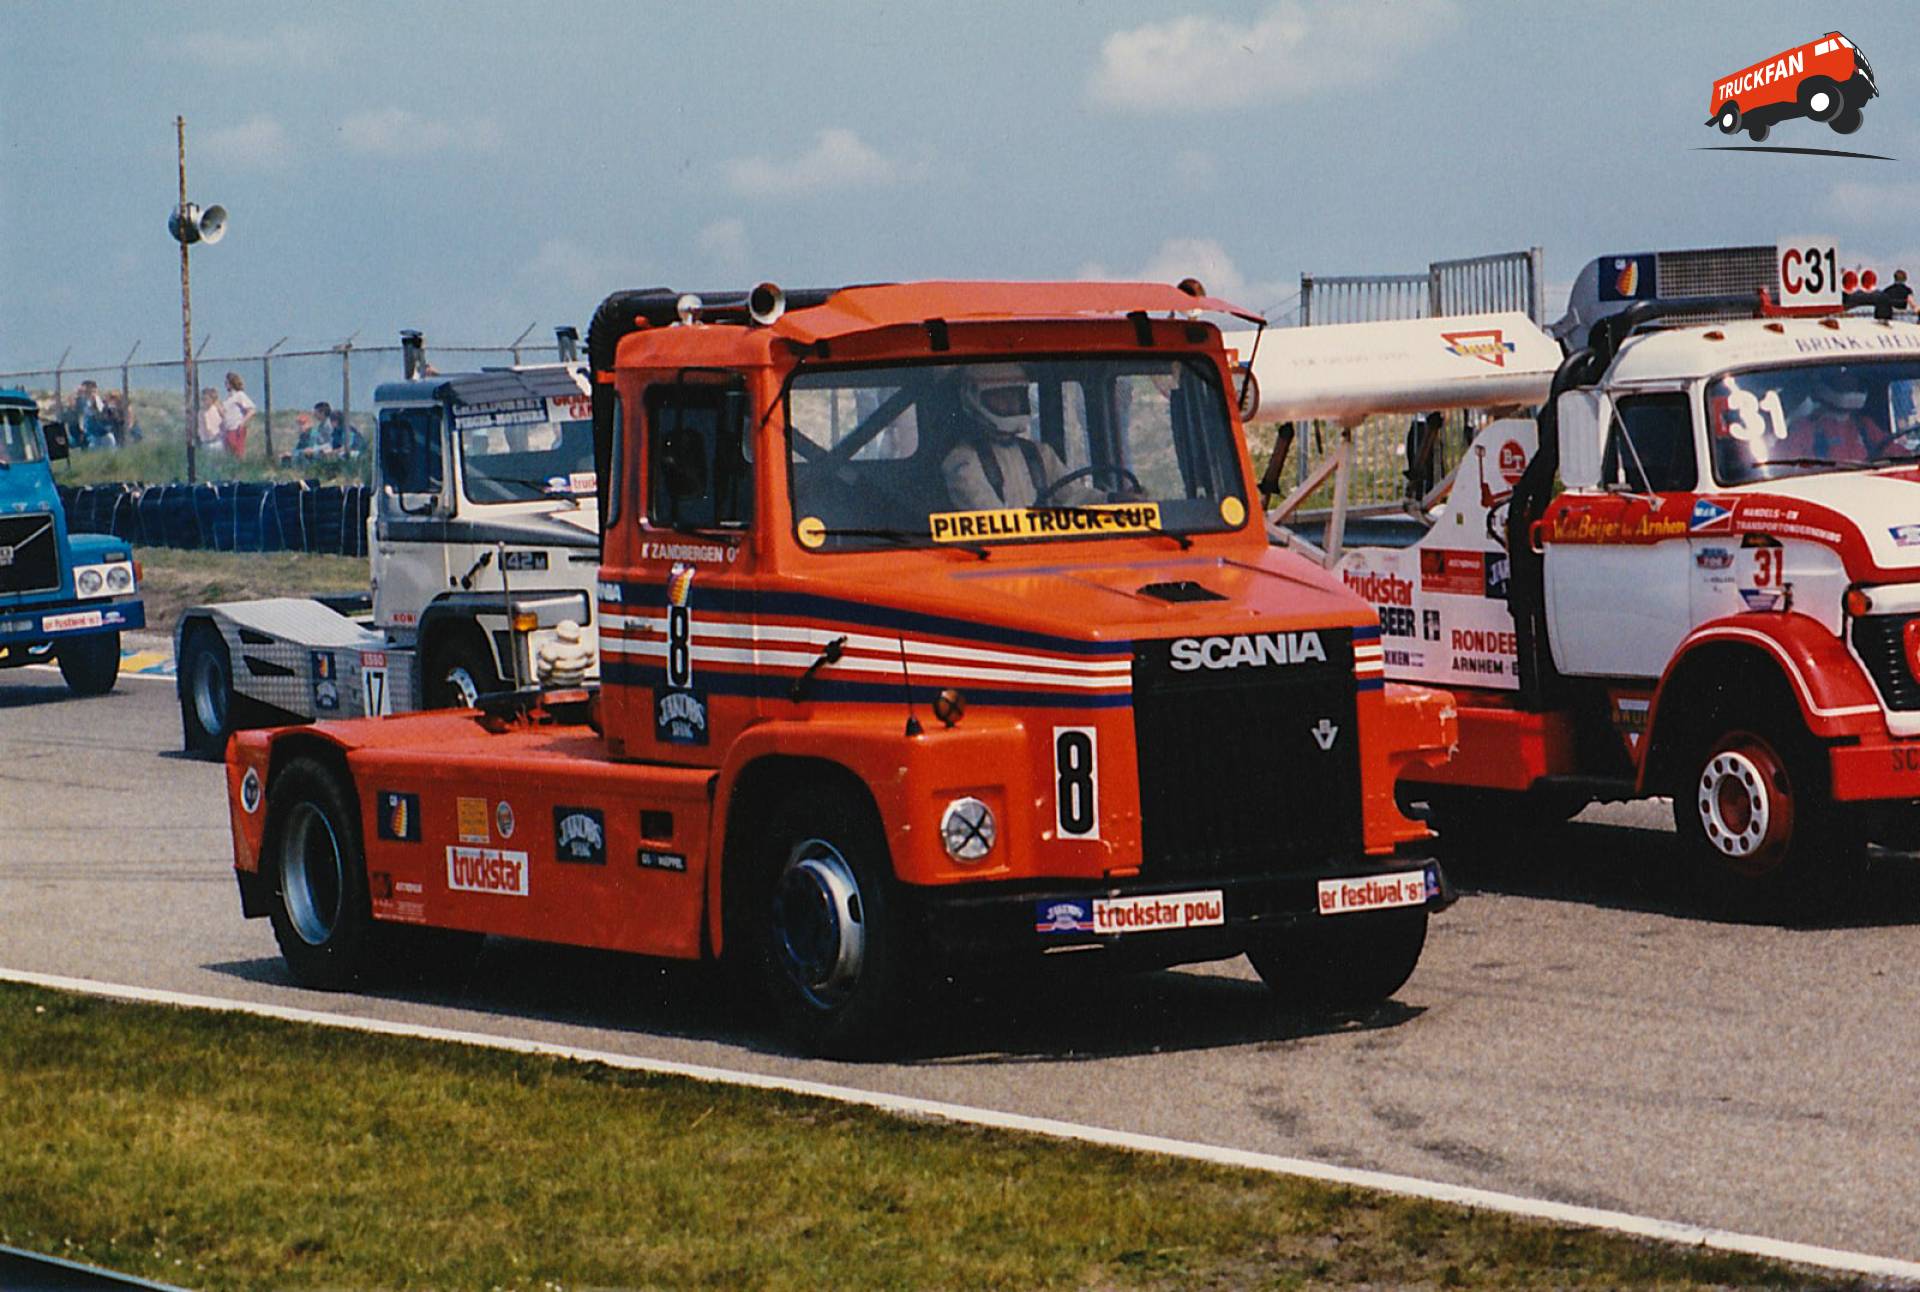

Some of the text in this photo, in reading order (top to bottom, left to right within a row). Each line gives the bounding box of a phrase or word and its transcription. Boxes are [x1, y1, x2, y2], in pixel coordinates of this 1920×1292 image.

[1782, 247, 1836, 295] C31
[933, 506, 1157, 538] PIRELLI TRUCK-CUP
[652, 543, 723, 562] ZANDBERGEN
[1753, 549, 1783, 587] 31
[671, 606, 689, 686] 8
[1169, 631, 1328, 672] SCANIA
[1452, 657, 1504, 674] ARNHEM
[366, 671, 384, 717] 17
[1057, 730, 1094, 835] 8
[452, 847, 522, 892] truckstar
[1321, 889, 1336, 909] er
[1341, 879, 1403, 907] festival
[1098, 901, 1179, 927] truckstar
[1184, 900, 1221, 928] pow
